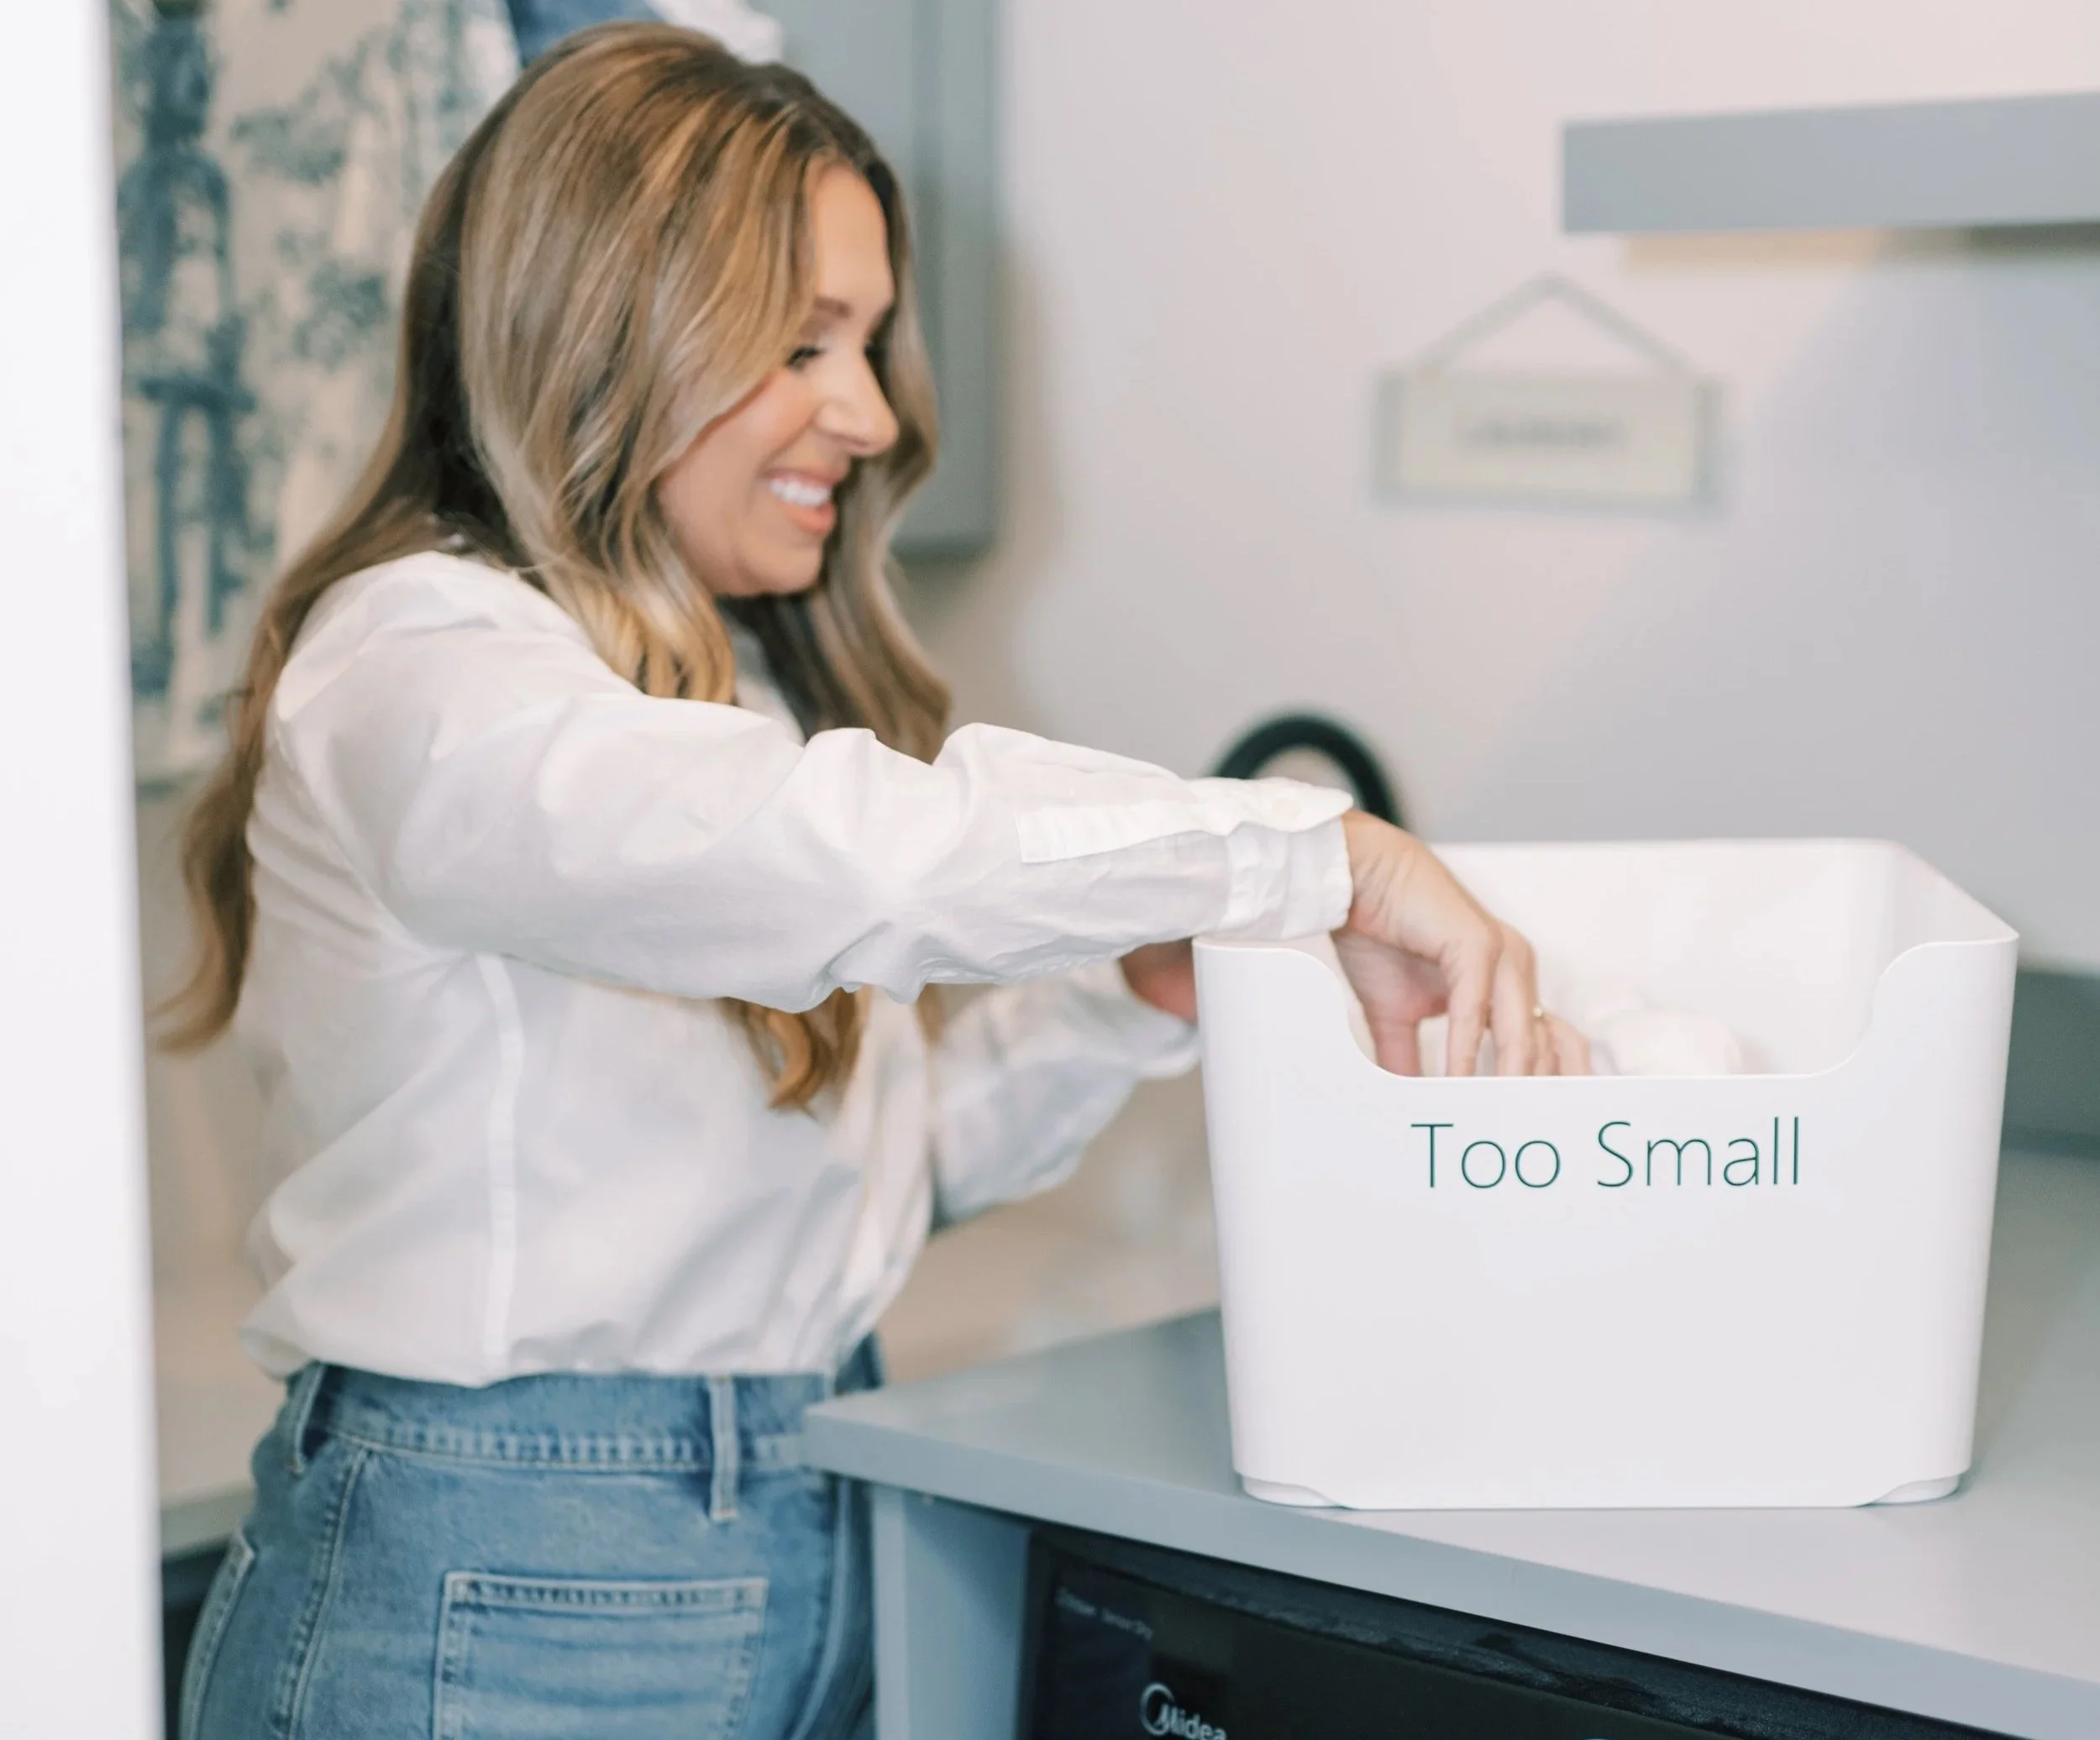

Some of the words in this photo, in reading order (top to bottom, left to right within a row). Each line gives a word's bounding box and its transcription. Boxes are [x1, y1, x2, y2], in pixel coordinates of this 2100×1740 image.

[1410, 1122, 1561, 1189] Too
[1596, 1115, 1799, 1188] Small
[1140, 1685, 1227, 1740] Midea
